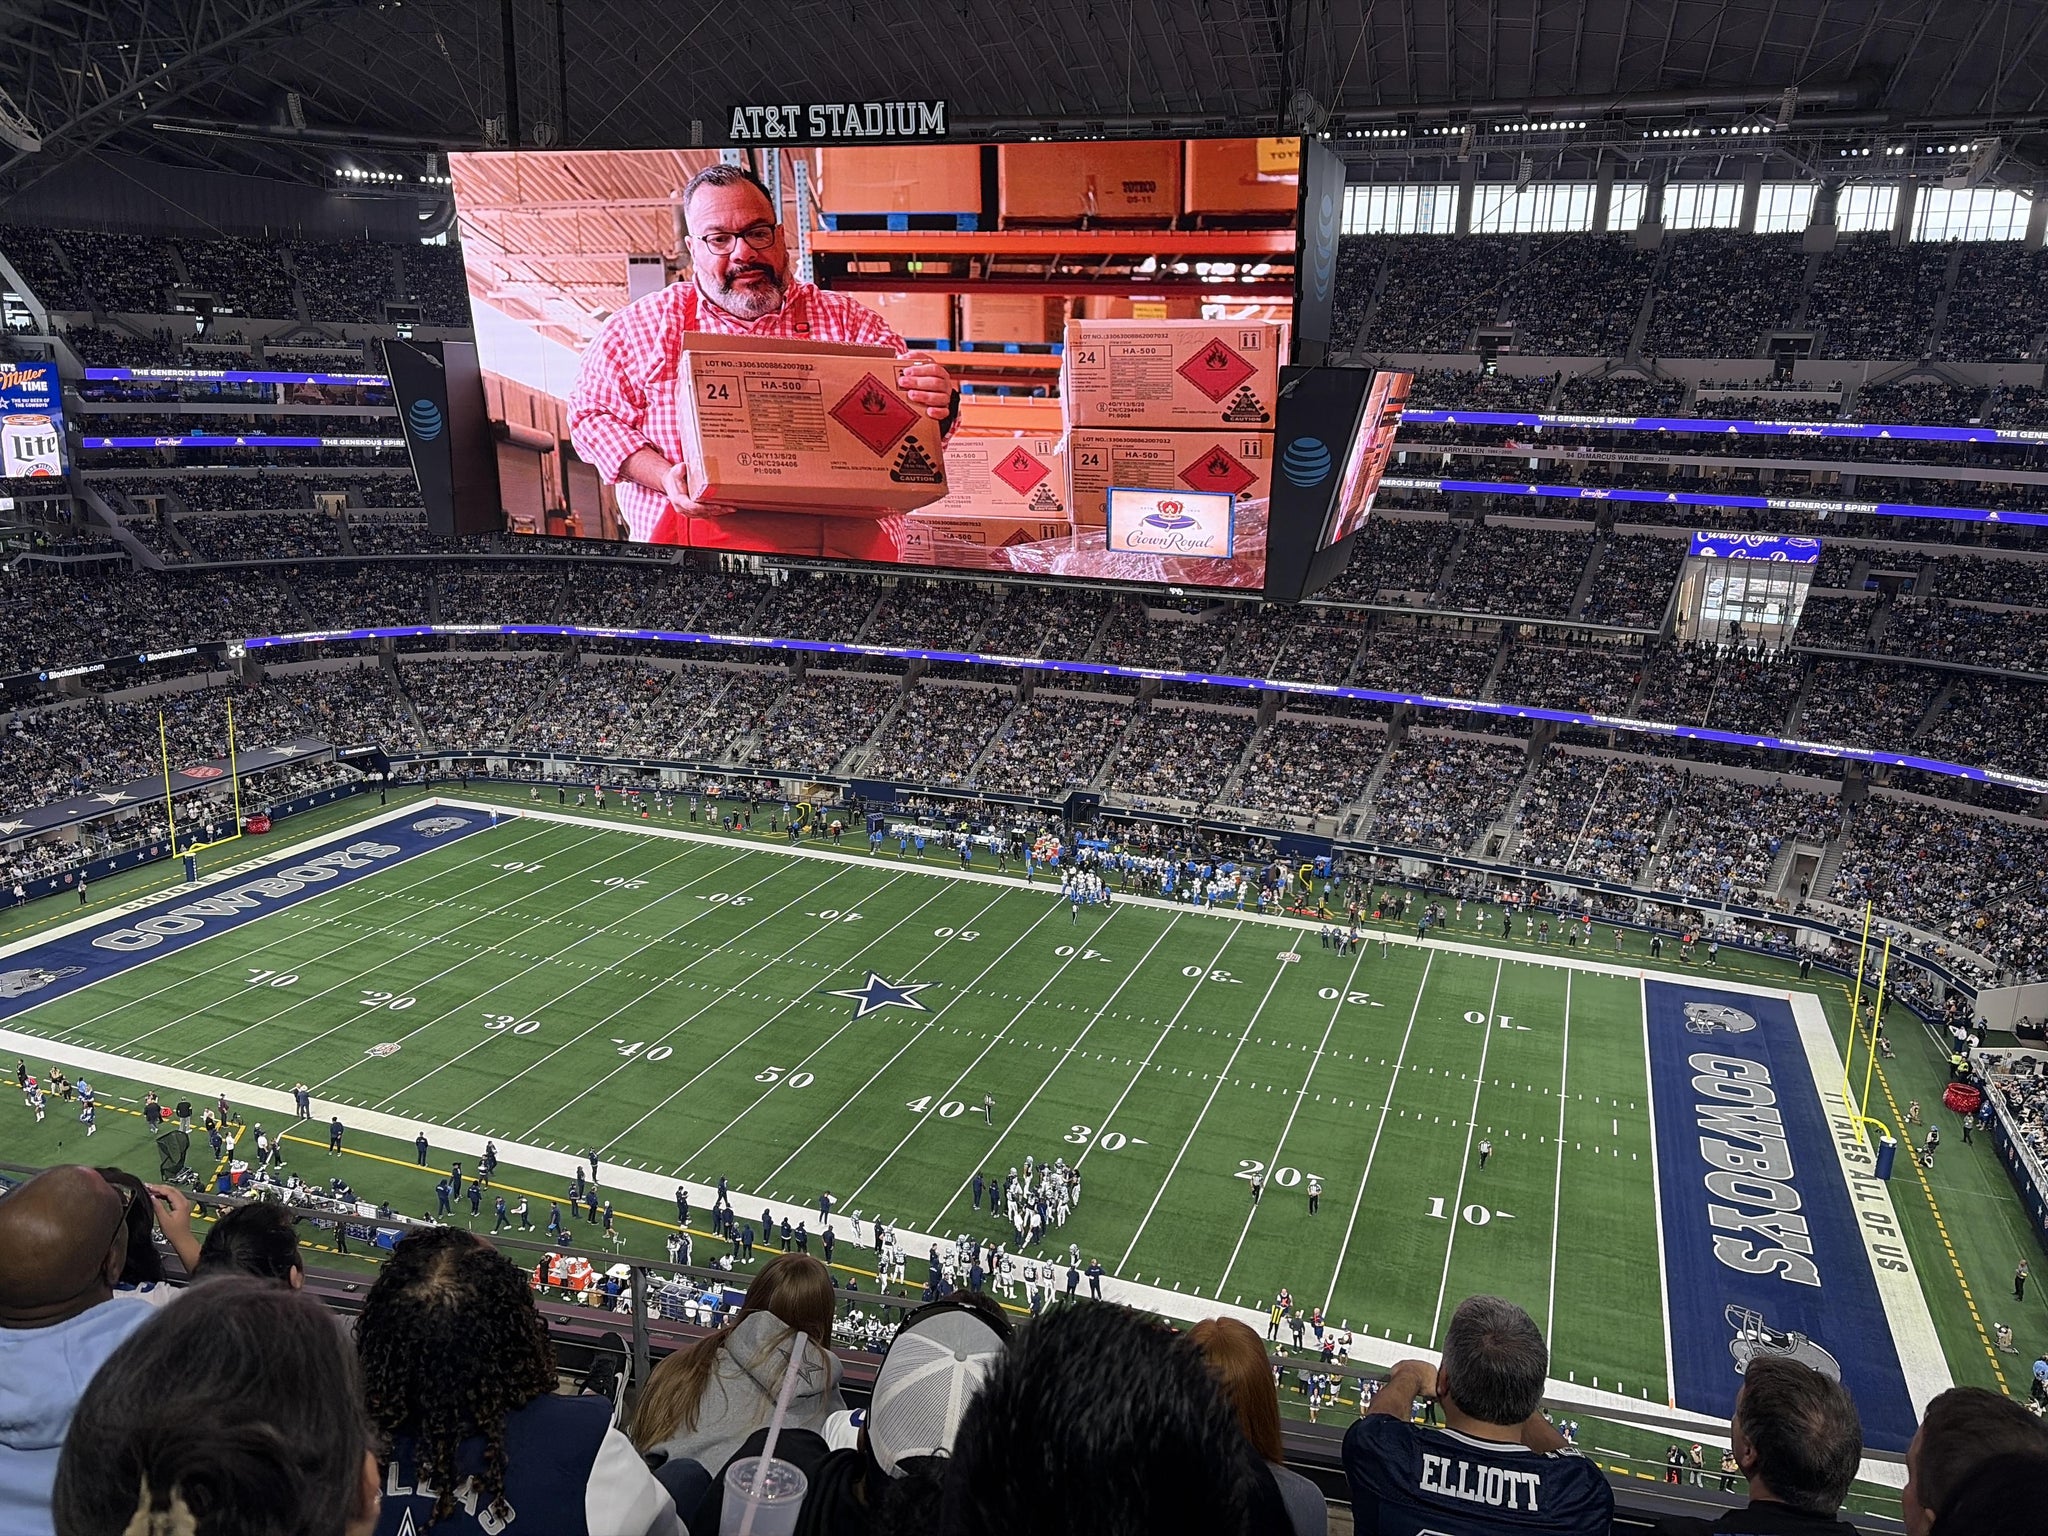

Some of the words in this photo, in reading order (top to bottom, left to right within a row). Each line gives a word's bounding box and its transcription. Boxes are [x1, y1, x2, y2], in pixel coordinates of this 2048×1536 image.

[730, 106, 800, 139] AT&T
[809, 101, 946, 137] STADIUM
[1078, 351, 1096, 364] 24
[0, 368, 46, 390] Miller
[21, 381, 48, 391] TIME
[761, 381, 801, 391] HA-500
[706, 383, 729, 400] 24
[1557, 415, 1605, 423] GENEROUS
[11, 434, 56, 462] Lite
[1081, 454, 1099, 466] 24
[1379, 479, 1413, 487] NEROUS
[1415, 480, 1442, 488] SPIRIT
[1788, 501, 1842, 510] GENEROUS
[1844, 503, 1878, 512] SPIRIT
[906, 534, 921, 545] 24
[1126, 530, 1167, 548] Crown
[1160, 532, 1214, 552] Royal
[147, 646, 198, 661] Blockchain.com
[229, 645, 246, 658] 25
[49, 663, 105, 679] Blockchain.com
[1608, 717, 1651, 727] GENEROUS
[1984, 770, 2002, 779] THE
[2003, 774, 2048, 788] GENEROU
[219, 855, 278, 876] LOVE
[92, 841, 401, 951] COWBOYS
[244, 970, 299, 987] 10
[367, 991, 417, 1011] 20
[484, 1015, 541, 1035] 30
[615, 1040, 673, 1061] 40
[754, 1066, 815, 1089] 50
[905, 1095, 965, 1119] 40
[1064, 1124, 1127, 1151] 30
[1233, 1159, 1302, 1187] 20
[1688, 1053, 1821, 1287] COWBOYS
[1849, 1169, 1885, 1202] ALL
[1425, 1196, 1491, 1226] 10
[1862, 1211, 1896, 1238] OF
[1872, 1243, 1908, 1273] US
[1419, 1453, 1541, 1512] ELLIOTT
